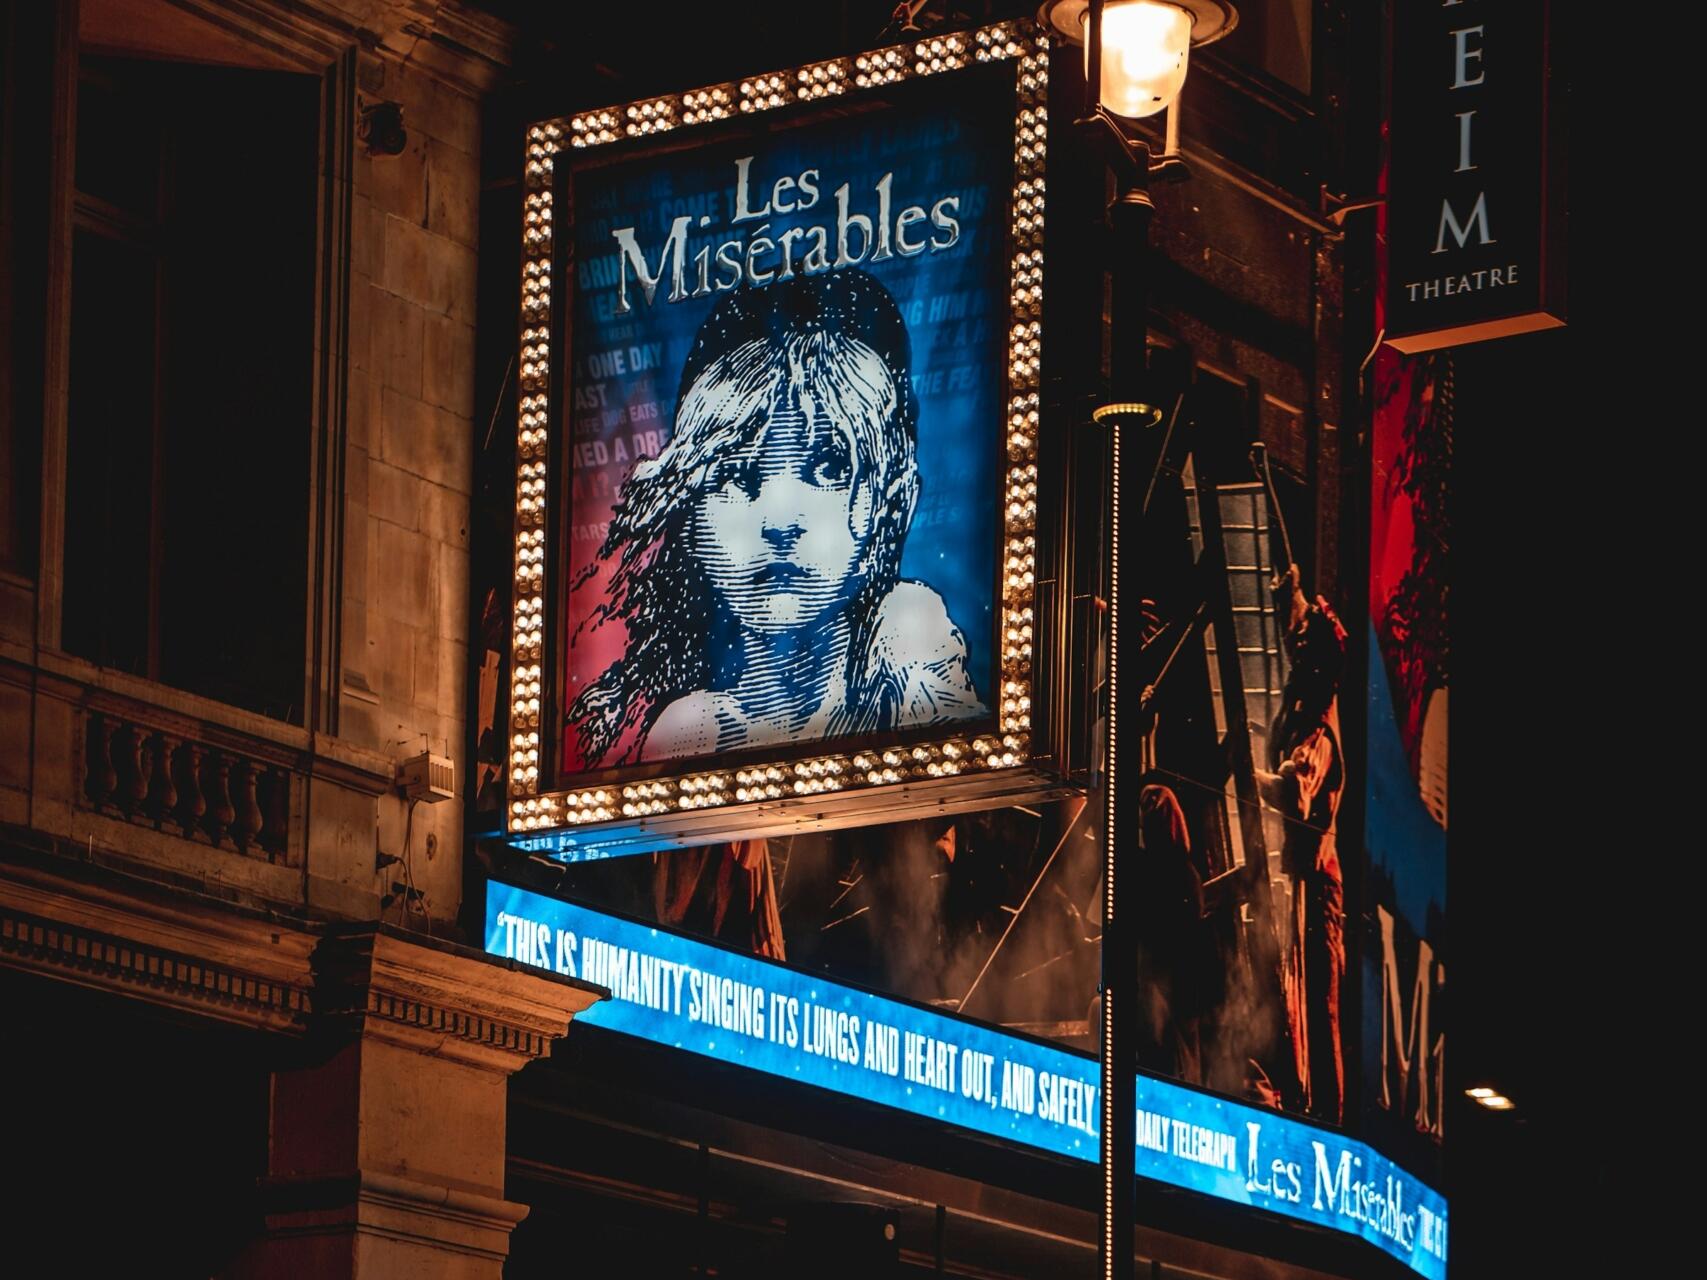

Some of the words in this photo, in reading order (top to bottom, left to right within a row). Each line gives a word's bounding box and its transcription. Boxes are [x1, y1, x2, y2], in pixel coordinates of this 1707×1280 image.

[1431, 0, 1497, 254] EIM
[731, 155, 820, 224] Les
[612, 172, 961, 315] Misérables
[1405, 264, 1519, 302] THEATRE
[588, 350, 625, 378] ONE
[629, 342, 663, 372] DAY
[629, 402, 659, 421] EATS
[615, 438, 629, 462] A
[556, 929, 577, 978] IS
[581, 936, 685, 1015] HUMANITY
[688, 969, 764, 1039] SINGING
[769, 991, 799, 1049] ITS
[803, 1002, 859, 1066] LUNGS
[864, 1021, 899, 1077] AND
[905, 1030, 958, 1093] HEART
[961, 1048, 998, 1109] OUT,
[1001, 1060, 1035, 1115] AND
[1038, 1072, 1096, 1133] SAFELY
[1135, 1109, 1170, 1154] DAILY
[1171, 1119, 1236, 1173] TELEGRAPH
[1245, 1121, 1302, 1204] Les
[1311, 1140, 1415, 1252] Misérables
